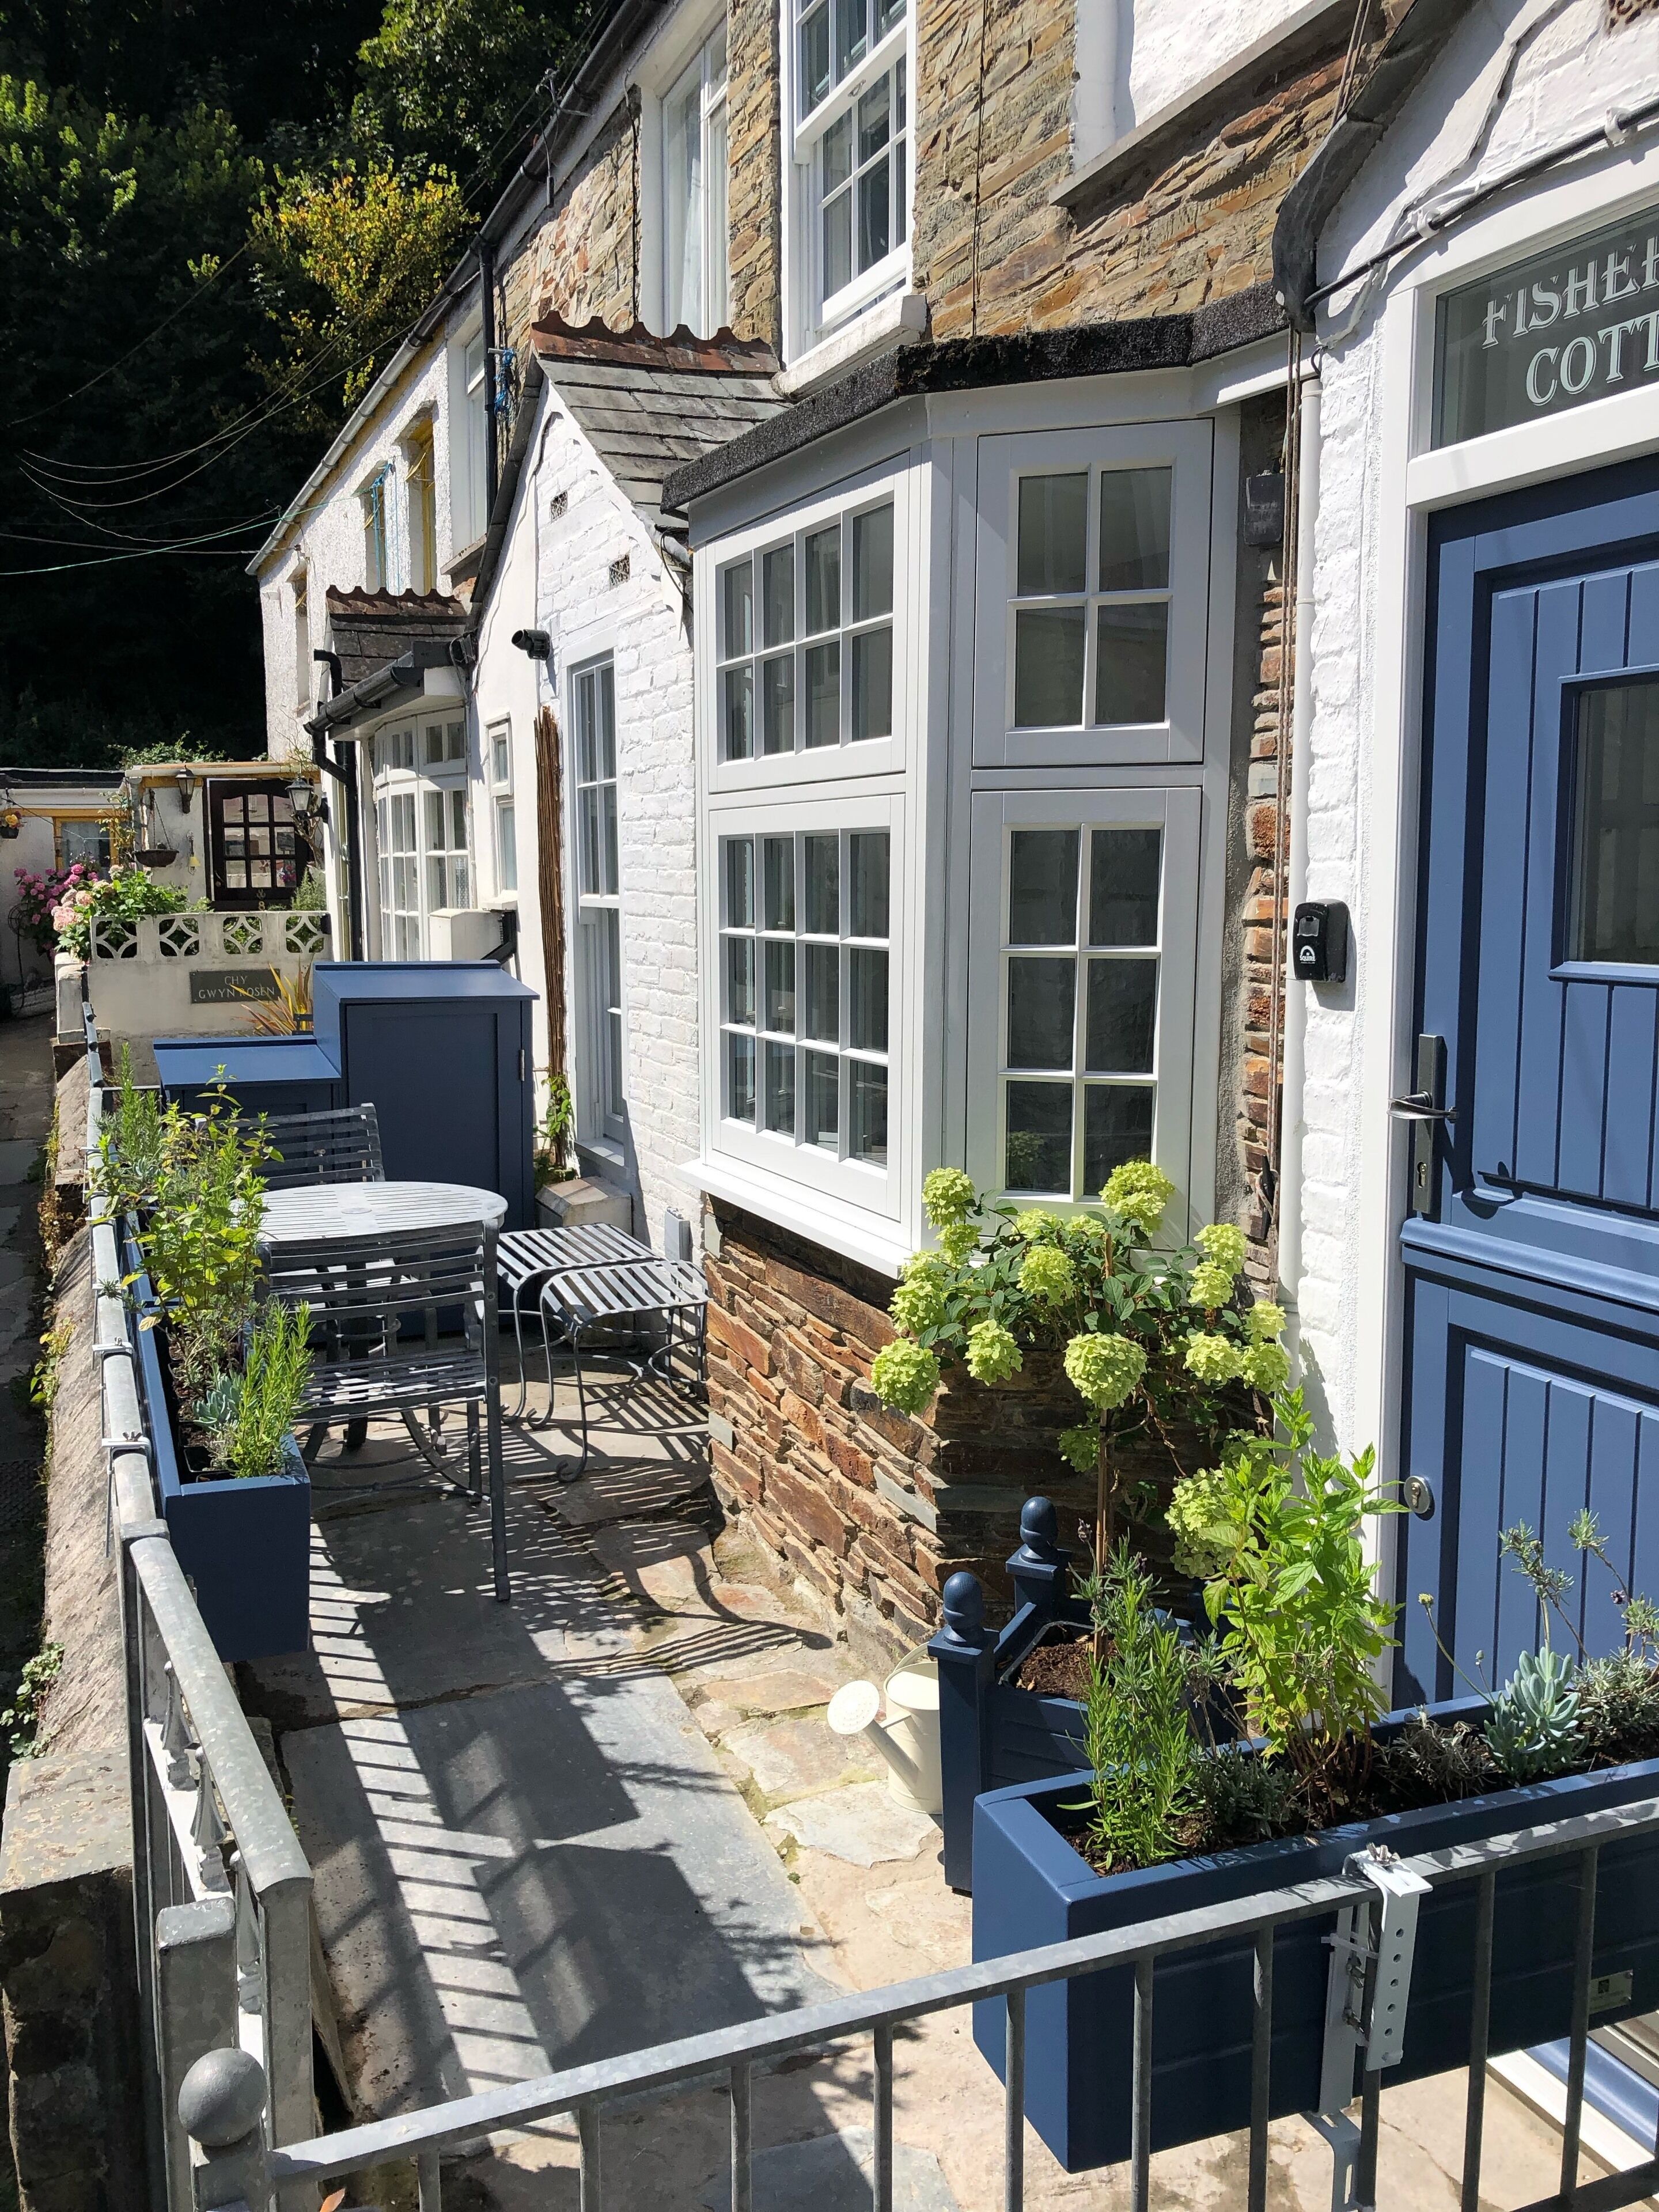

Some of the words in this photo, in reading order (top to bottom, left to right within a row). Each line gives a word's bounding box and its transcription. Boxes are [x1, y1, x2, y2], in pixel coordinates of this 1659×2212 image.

[258, 901, 265, 911] 8
[224, 975, 248, 985] CHY
[198, 988, 235, 999] GWYN
